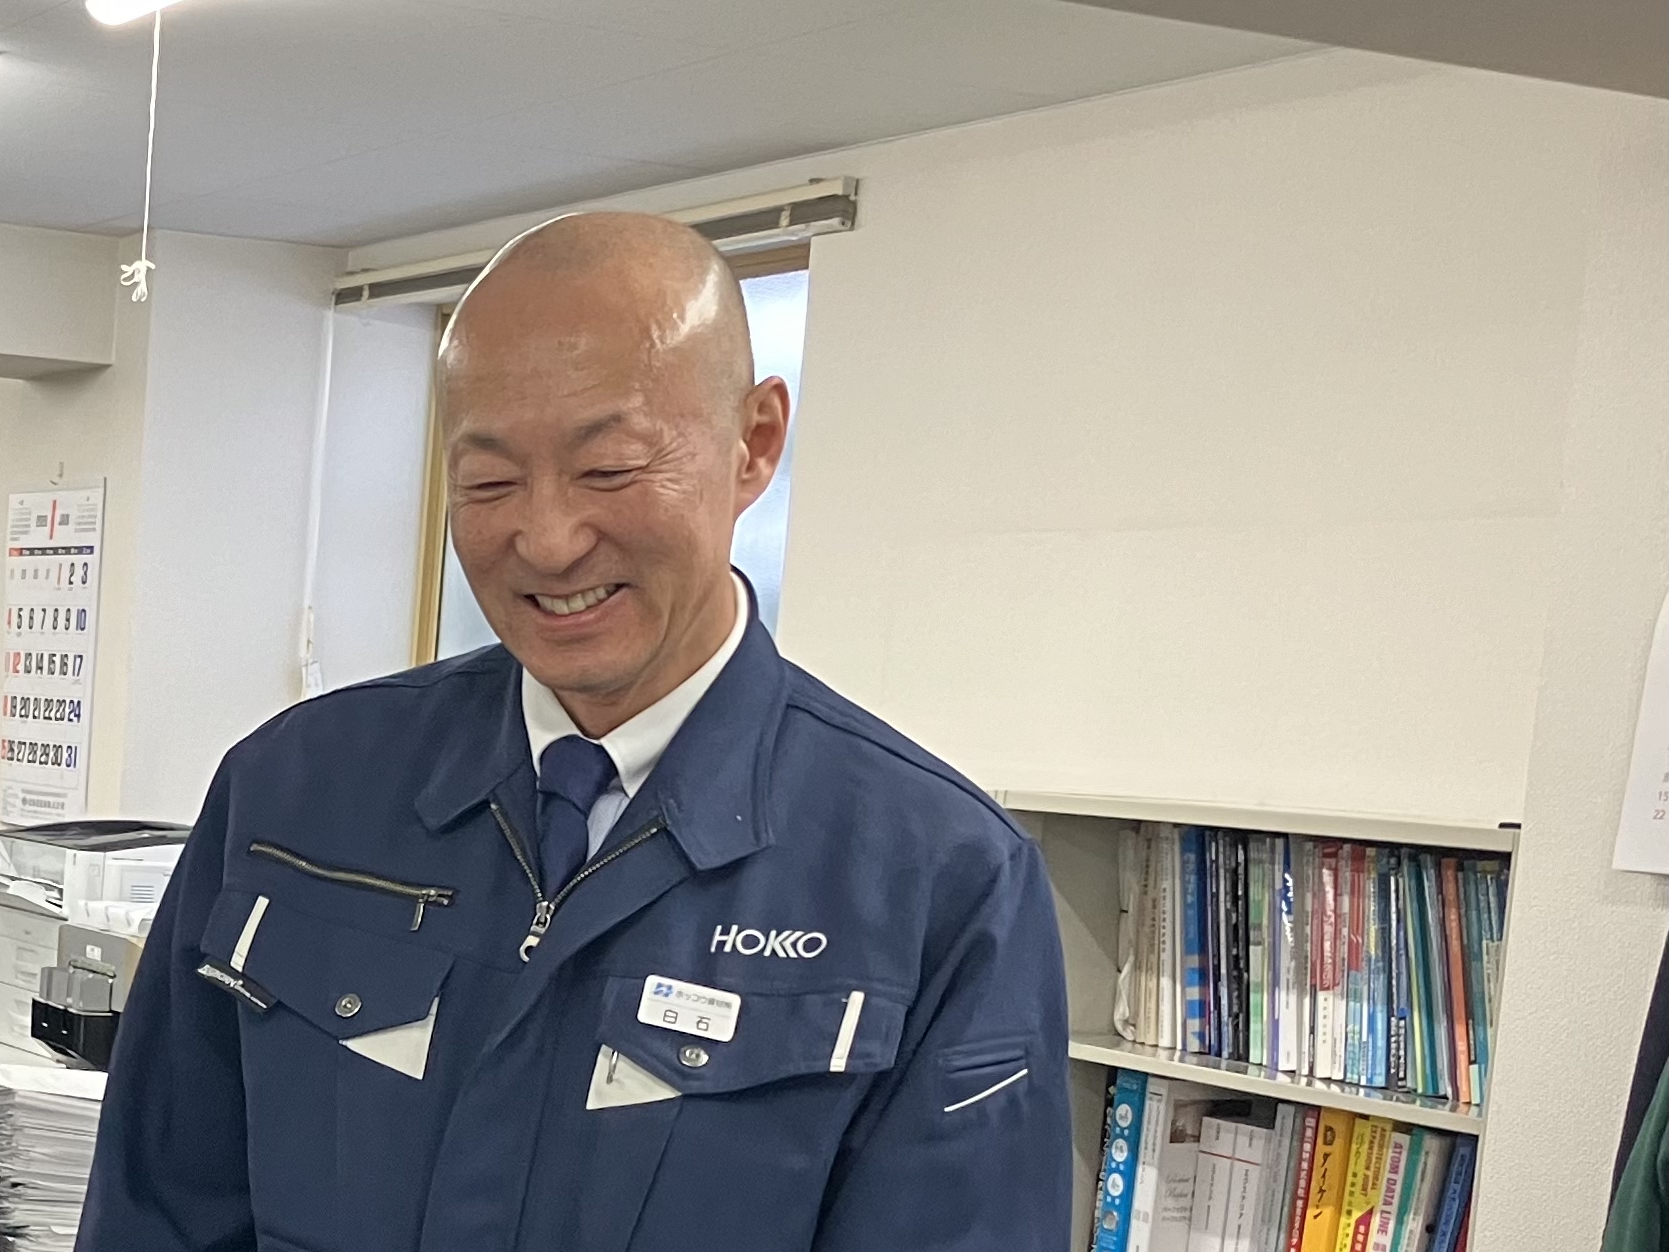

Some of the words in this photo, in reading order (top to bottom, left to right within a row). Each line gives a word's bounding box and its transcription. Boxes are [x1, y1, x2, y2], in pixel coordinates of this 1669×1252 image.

[68, 562, 75, 585] 2
[81, 562, 88, 585] 3
[17, 607, 23, 630] 5
[28, 607, 34, 630] 6
[40, 608, 46, 630] 7
[52, 608, 59, 630] 8
[64, 608, 71, 631] 9
[76, 608, 86, 631] 10
[24, 652, 32, 674] 13
[35, 652, 44, 675] 14
[47, 653, 56, 676] 15
[59, 653, 69, 676] 16
[72, 654, 83, 677] 17
[10, 695, 17, 717] 19
[19, 696, 30, 719] 20
[32, 697, 42, 719] 21
[43, 698, 54, 720] 22
[54, 699, 66, 721] 23
[67, 699, 81, 723] 24
[16, 740, 26, 763] 27
[27, 741, 38, 764] 28
[39, 743, 50, 765] 29
[51, 744, 63, 767] 30
[65, 745, 77, 768] 31
[1653, 809, 1666, 820] 22
[710, 924, 828, 959] HOKKO
[1388, 1141, 1404, 1175] ATOM
[1382, 1176, 1397, 1207] DATA
[1377, 1209, 1392, 1237] LINE
